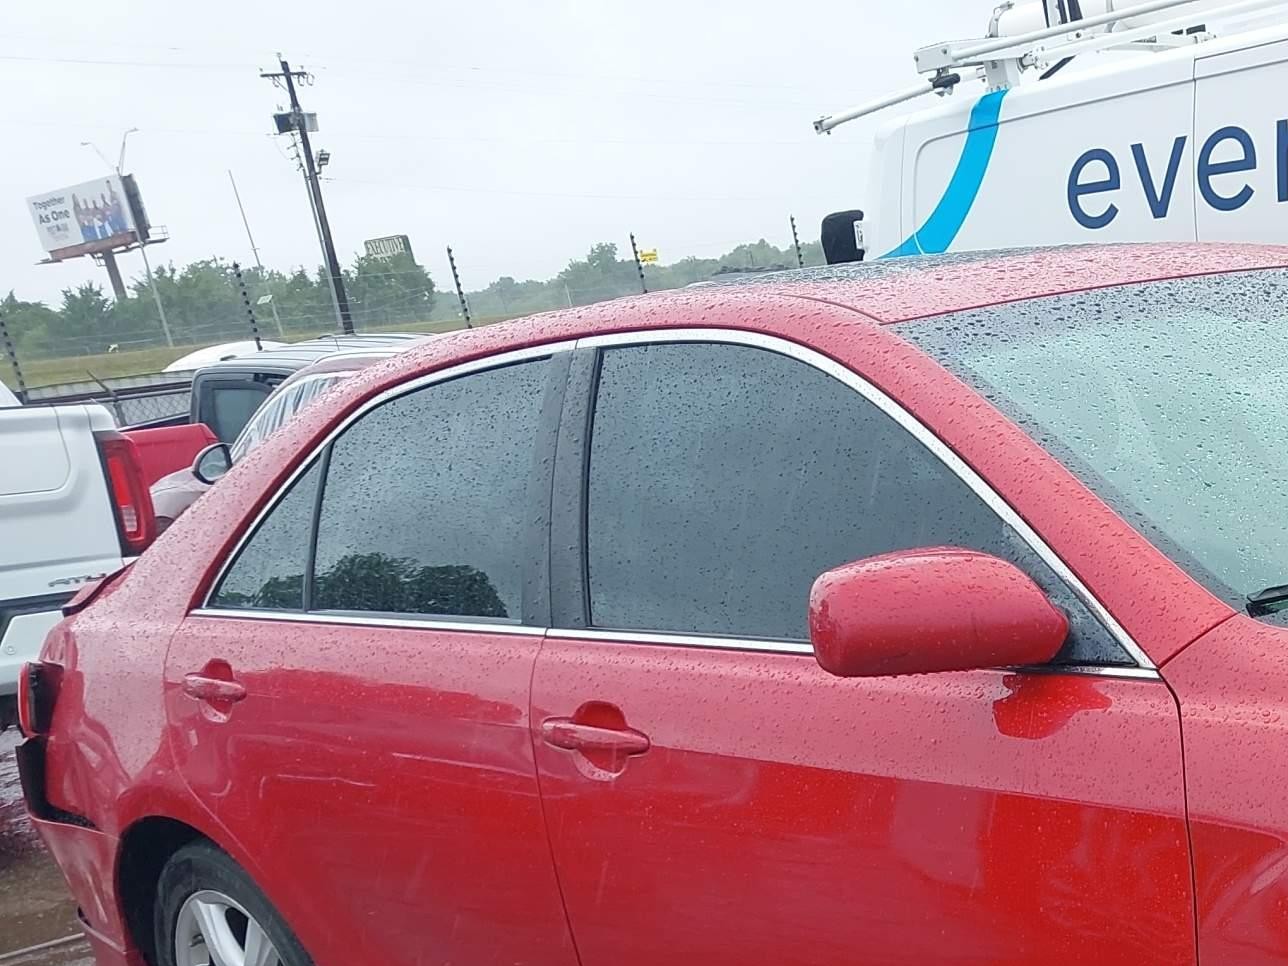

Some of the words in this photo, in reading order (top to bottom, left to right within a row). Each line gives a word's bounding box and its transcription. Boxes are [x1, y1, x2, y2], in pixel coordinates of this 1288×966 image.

[32, 196, 65, 210] Together
[38, 213, 52, 225] As
[51, 209, 71, 222] One
